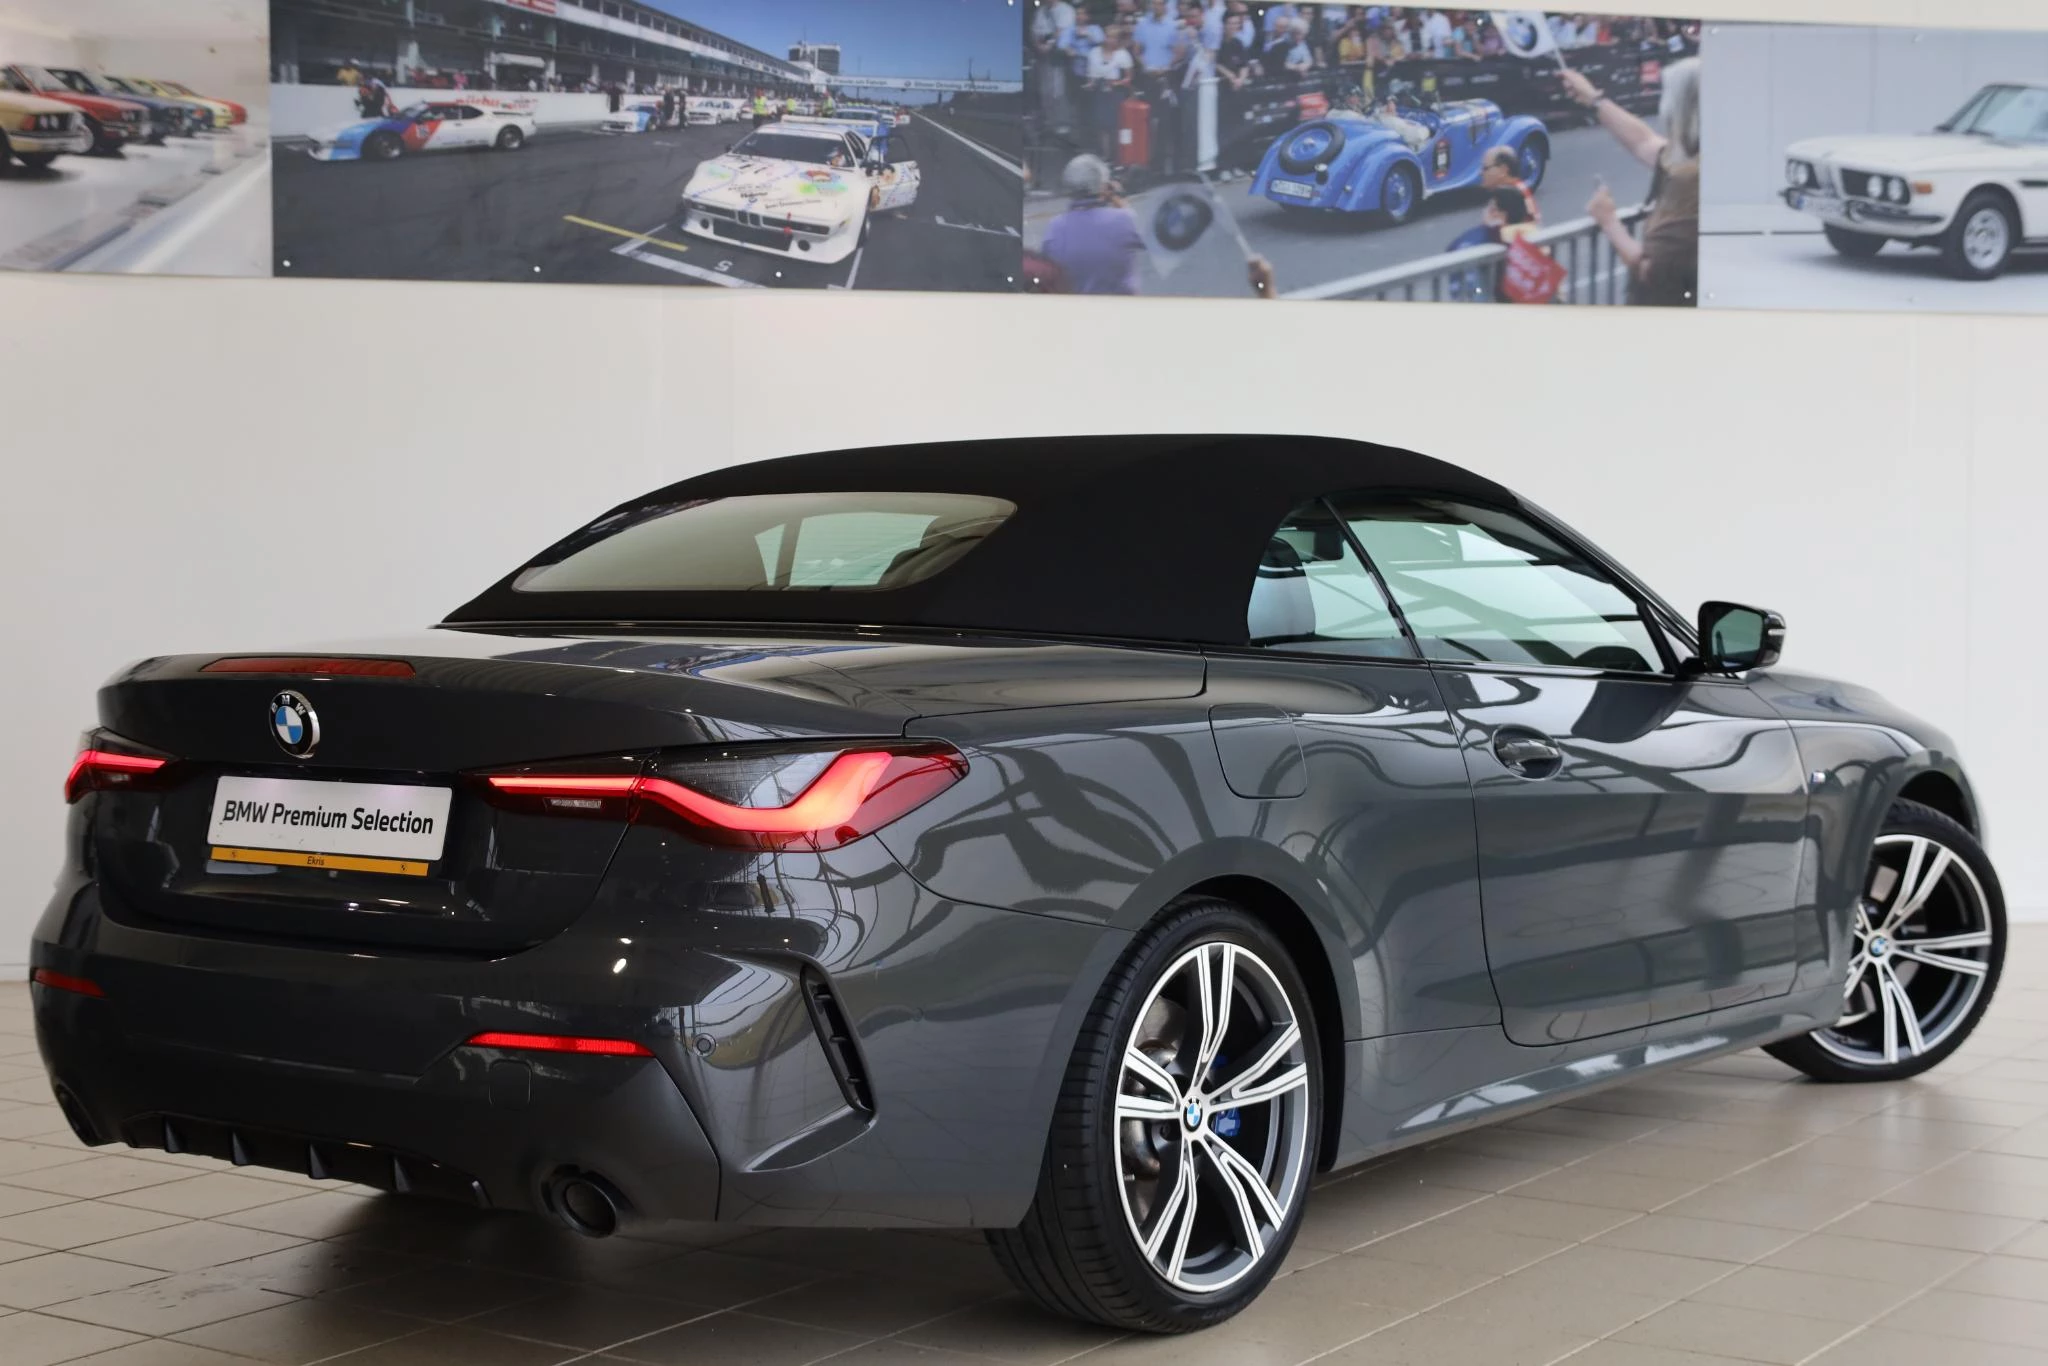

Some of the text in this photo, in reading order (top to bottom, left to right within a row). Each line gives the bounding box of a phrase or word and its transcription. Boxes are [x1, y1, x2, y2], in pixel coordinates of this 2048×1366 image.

[271, 694, 306, 716] BMW
[223, 800, 434, 834] BMW Premium Selection
[306, 856, 325, 867] Ekris
